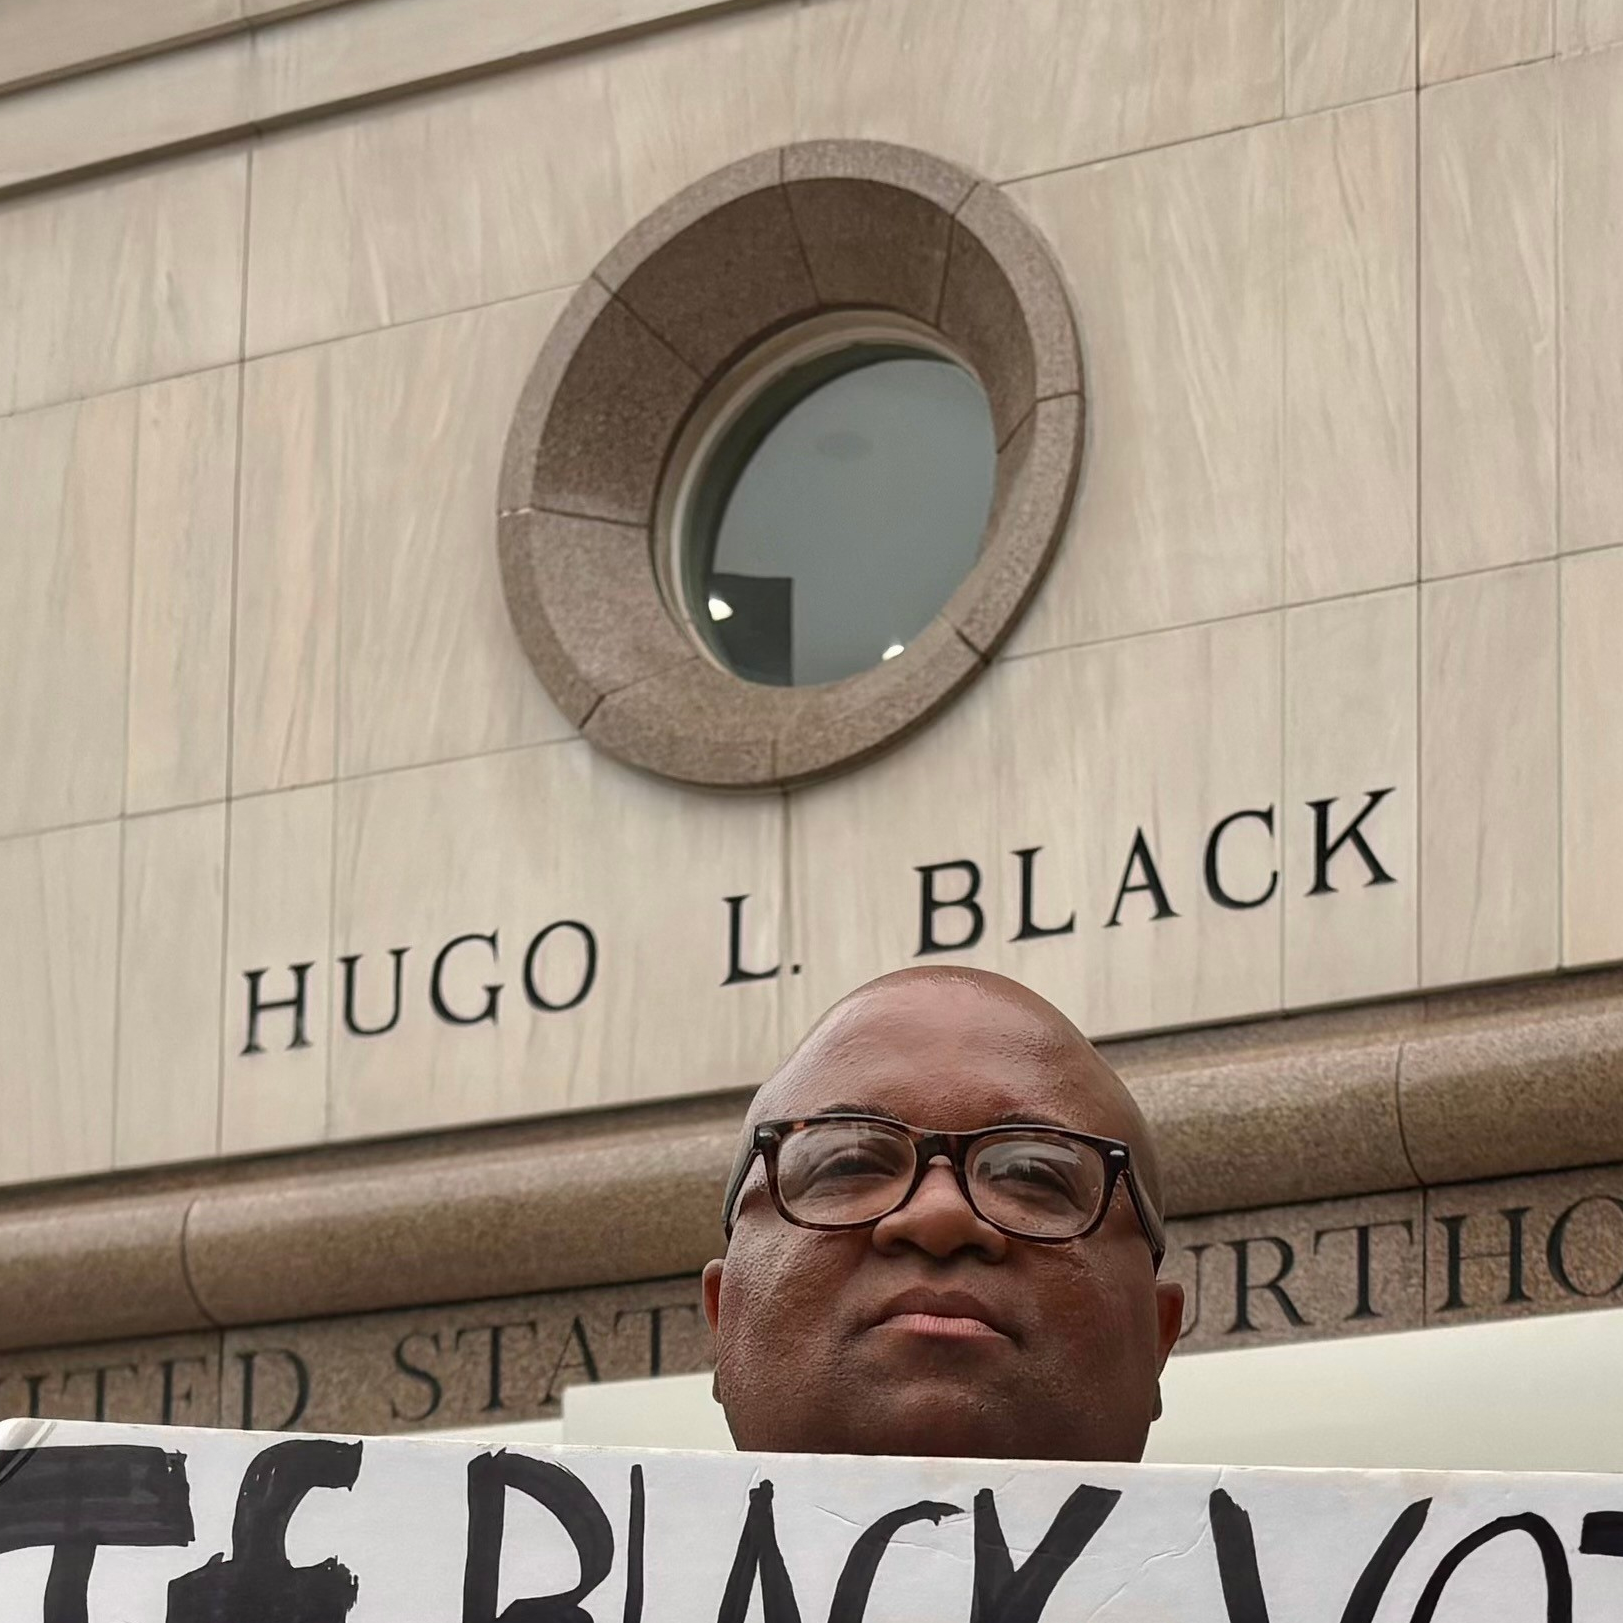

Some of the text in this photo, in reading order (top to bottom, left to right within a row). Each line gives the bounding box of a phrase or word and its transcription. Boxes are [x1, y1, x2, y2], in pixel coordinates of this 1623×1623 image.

[239, 788, 1397, 1056] HUGO L. BLACK
